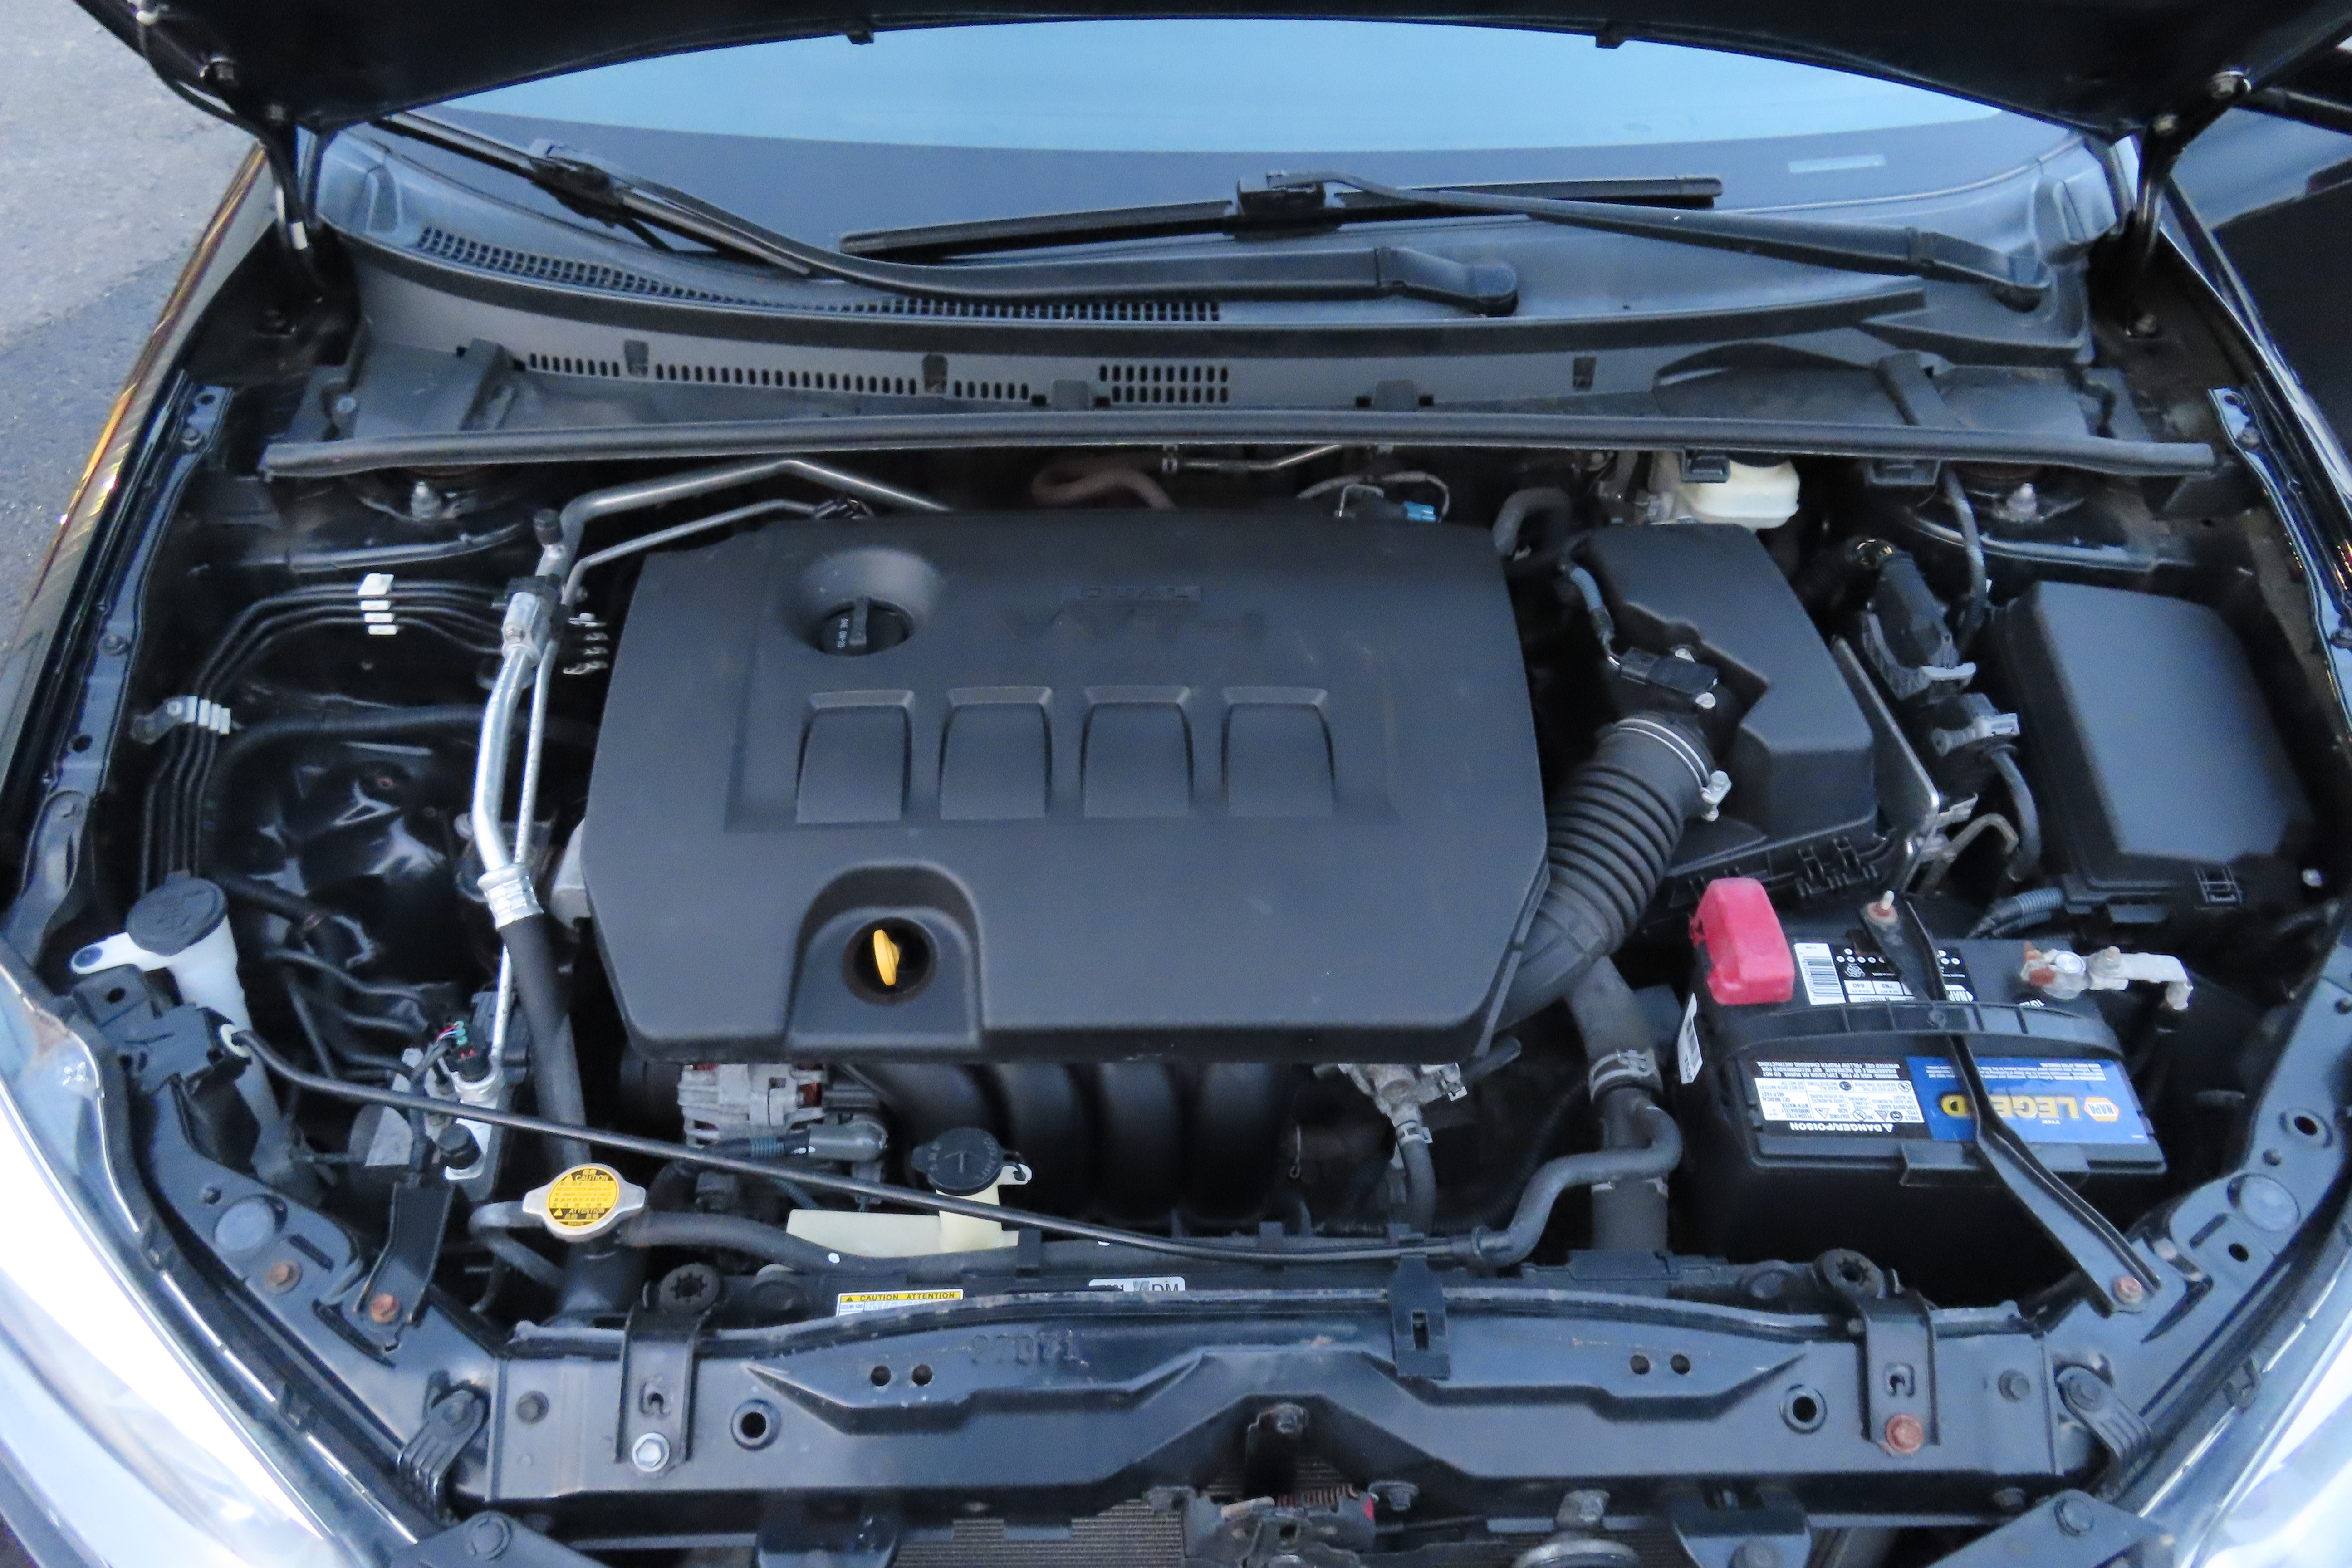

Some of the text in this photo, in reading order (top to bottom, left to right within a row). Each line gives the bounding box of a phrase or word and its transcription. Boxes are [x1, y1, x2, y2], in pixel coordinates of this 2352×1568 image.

[1948, 991, 1965, 1002] NAP
[1940, 1094, 2080, 1120] LEGED
[2088, 1103, 2113, 1116] NAPA
[1789, 1122, 1882, 1132] DANGER/POISON
